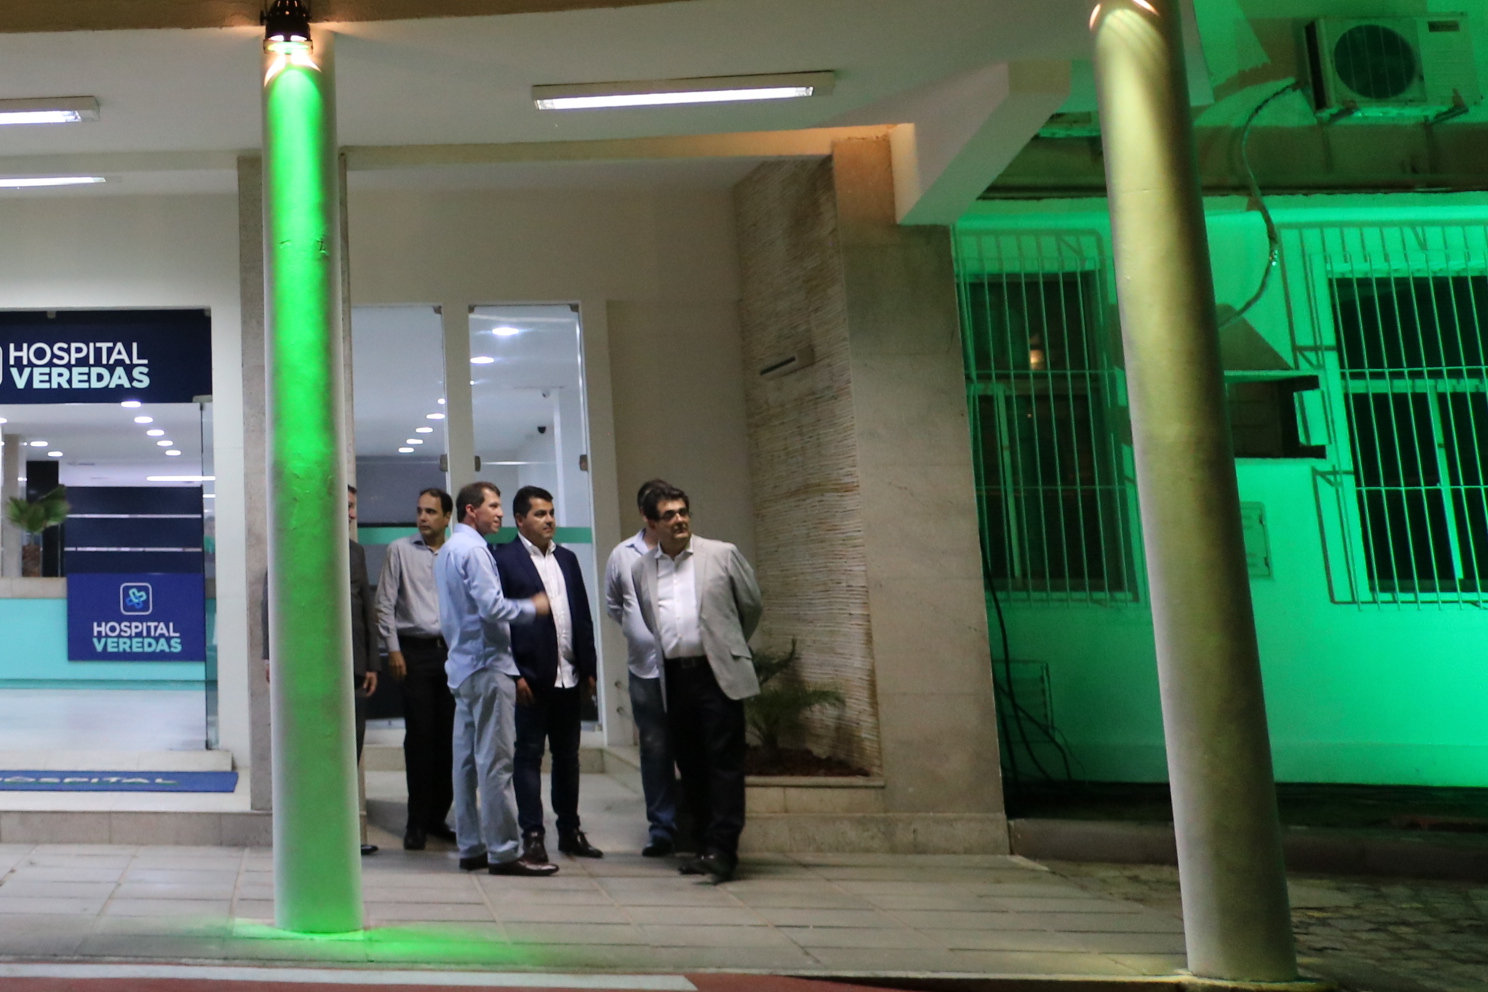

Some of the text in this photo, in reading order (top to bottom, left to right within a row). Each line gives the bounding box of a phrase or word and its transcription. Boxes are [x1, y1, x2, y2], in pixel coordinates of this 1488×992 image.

[9, 342, 149, 366] HOSPITAL
[10, 366, 151, 389] VEREDAS
[92, 621, 181, 637] HOSPITAL
[92, 637, 183, 653] VEREDAS
